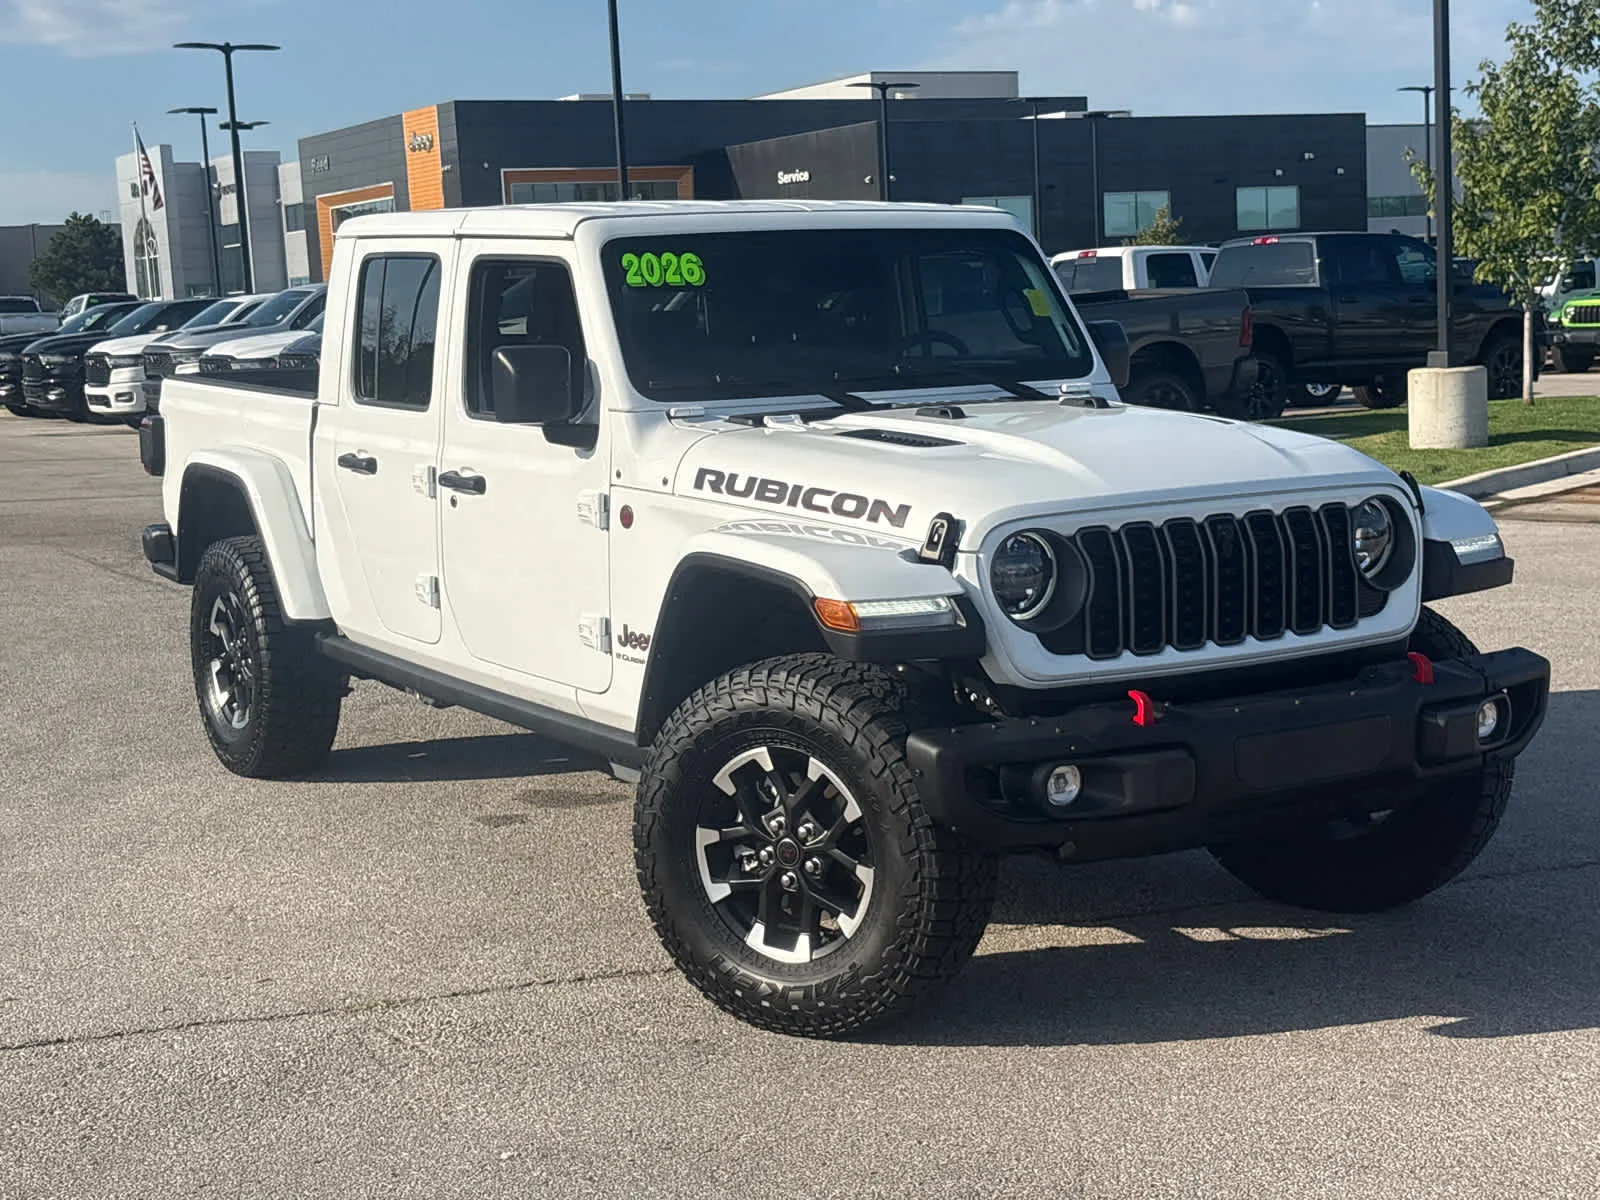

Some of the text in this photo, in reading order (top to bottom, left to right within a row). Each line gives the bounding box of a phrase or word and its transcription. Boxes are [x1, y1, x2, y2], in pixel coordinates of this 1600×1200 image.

[777, 169, 810, 185] Service
[621, 252, 706, 287] 2026
[693, 467, 912, 528] RUBICON
[617, 623, 651, 652] Jee
